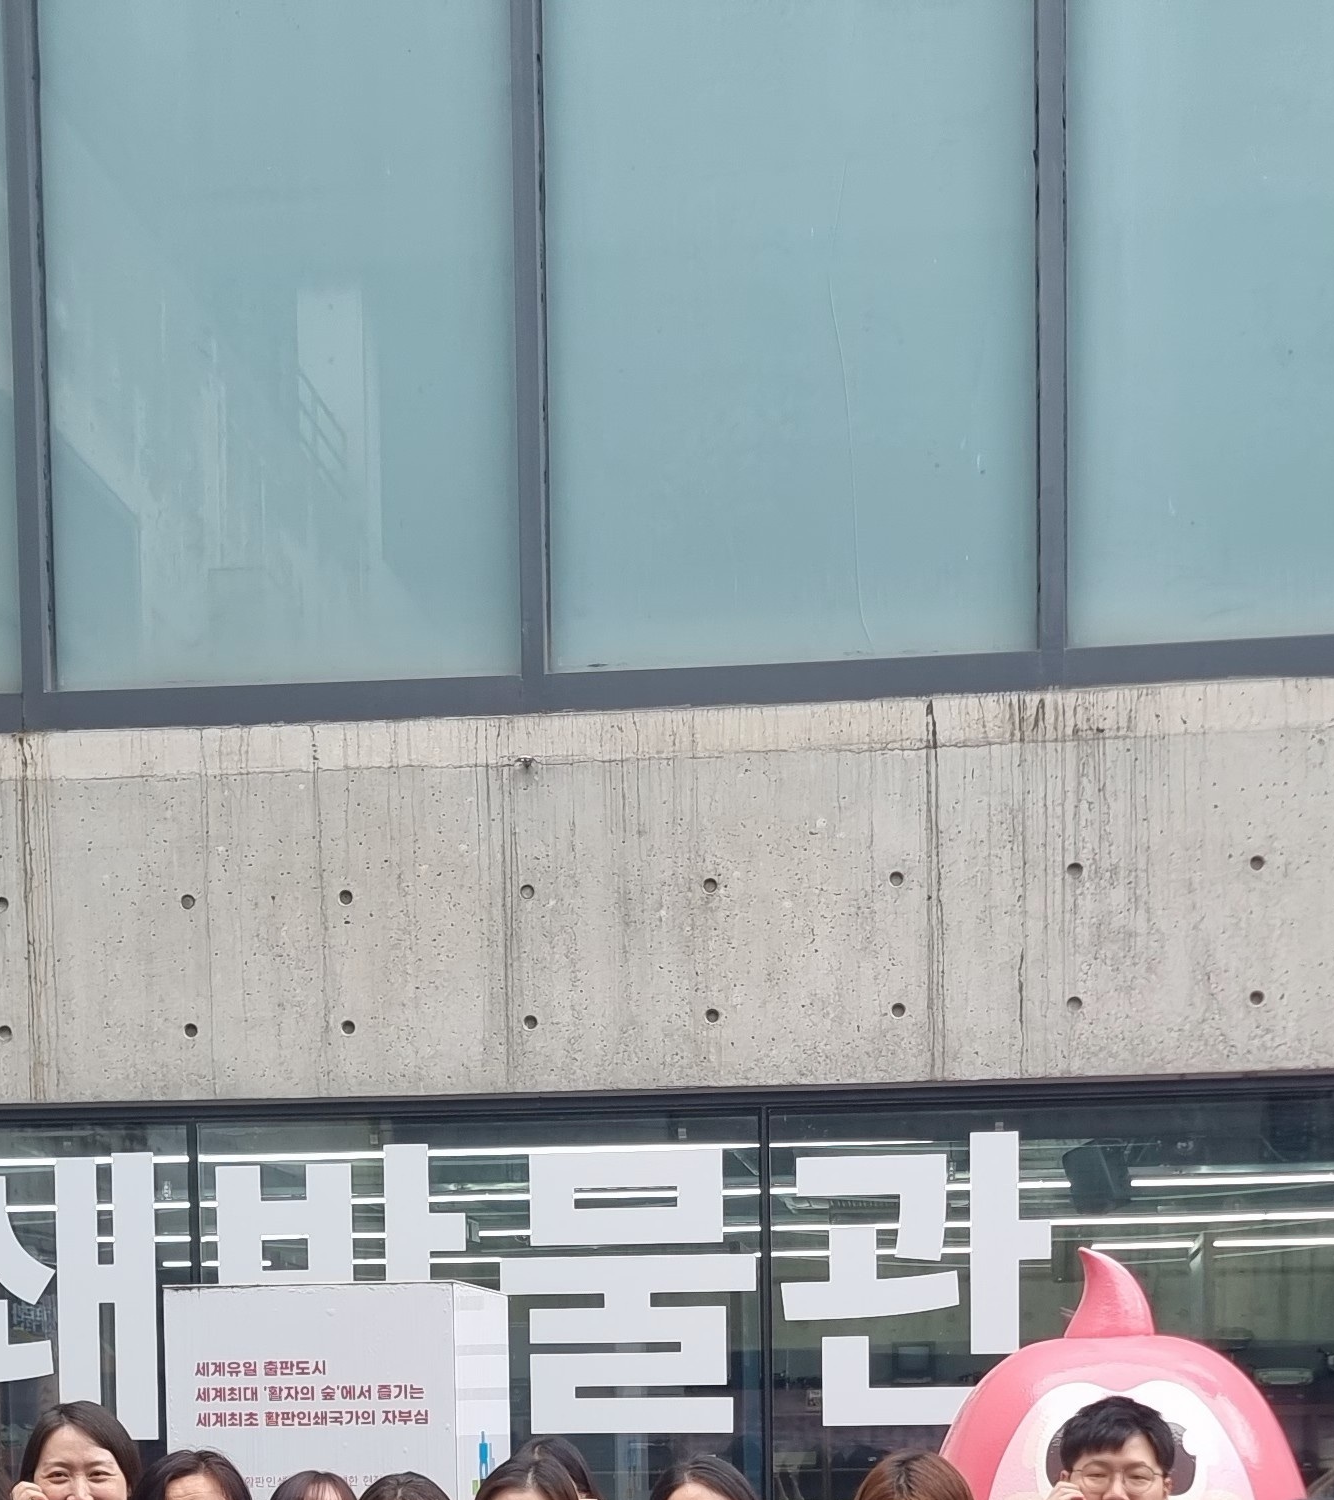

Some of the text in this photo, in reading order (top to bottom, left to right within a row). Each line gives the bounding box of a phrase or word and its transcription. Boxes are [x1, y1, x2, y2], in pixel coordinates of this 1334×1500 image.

[195, 1360, 326, 1377] 세계유일 출판도시
[195, 1386, 258, 1402] 세계최대
[321, 1384, 372, 1400] 숲'에서
[377, 1384, 424, 1400] 즐기는
[196, 1409, 429, 1427] 세계최초 활판인쇄국가의 자부심
